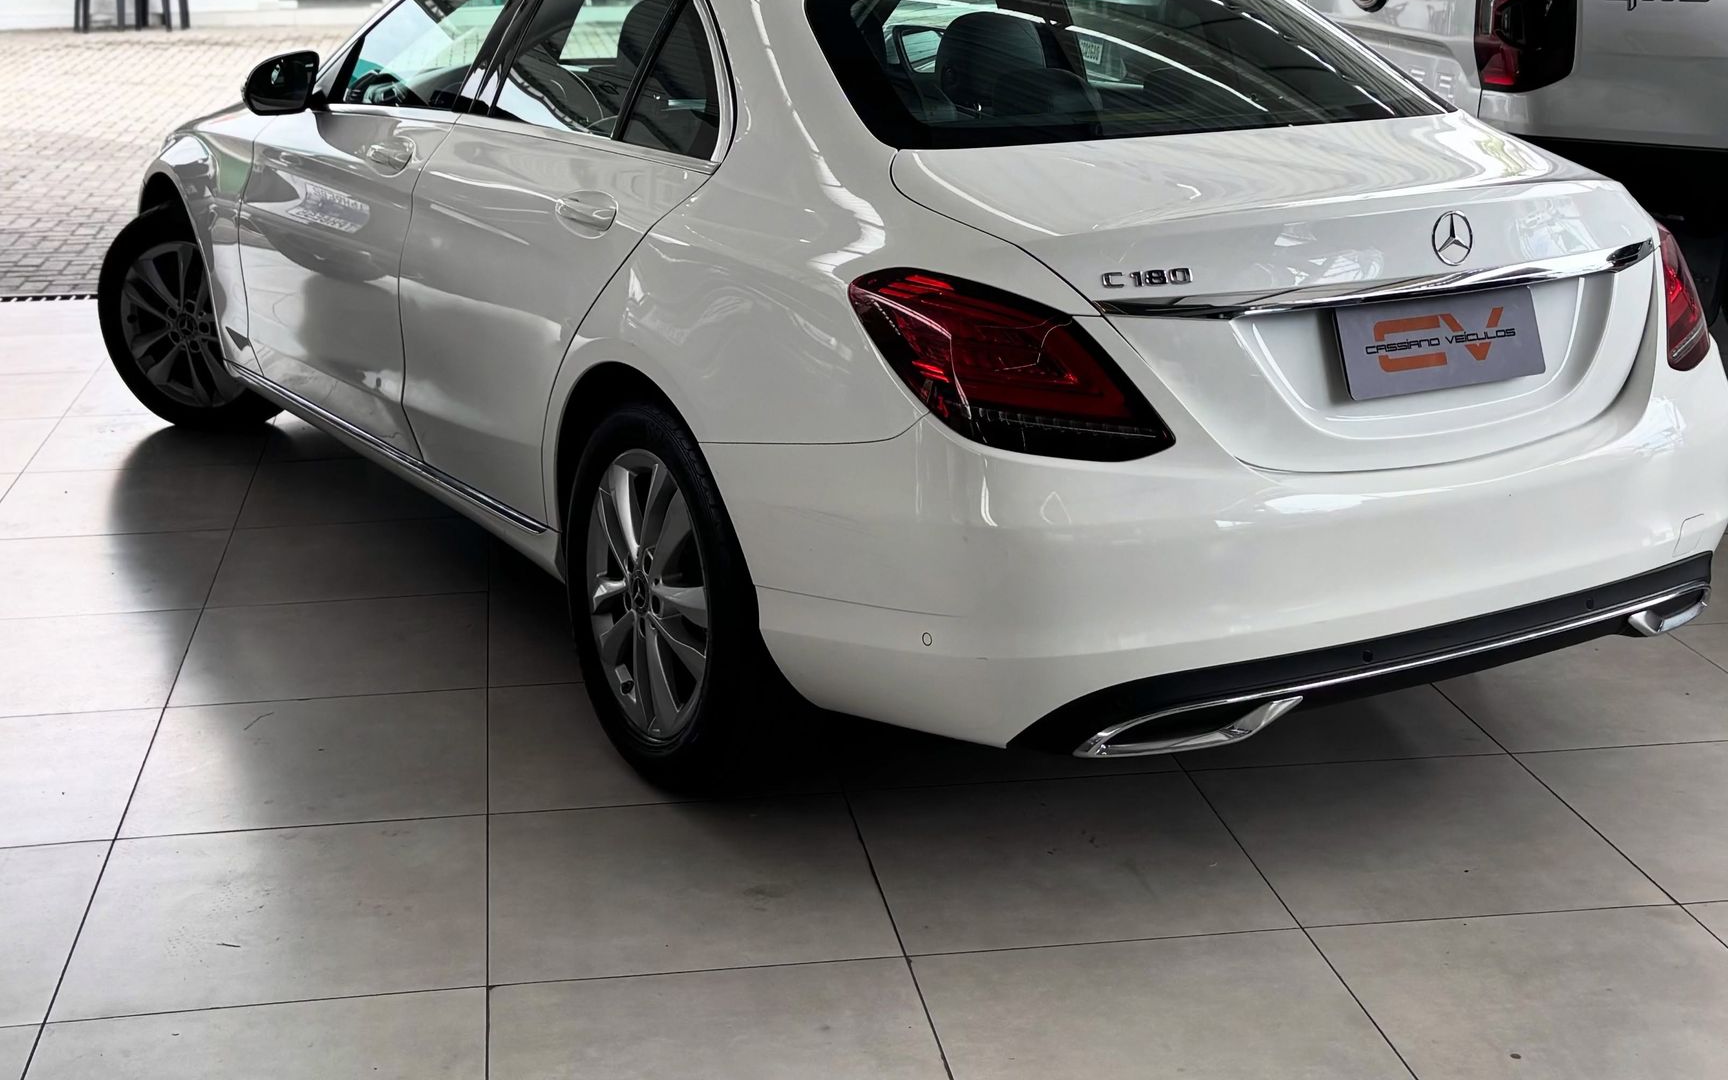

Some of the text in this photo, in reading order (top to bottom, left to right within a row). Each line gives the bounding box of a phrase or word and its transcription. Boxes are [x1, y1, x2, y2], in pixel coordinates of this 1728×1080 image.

[1102, 267, 1193, 289] C 180
[1365, 338, 1440, 354] CASSIANO
